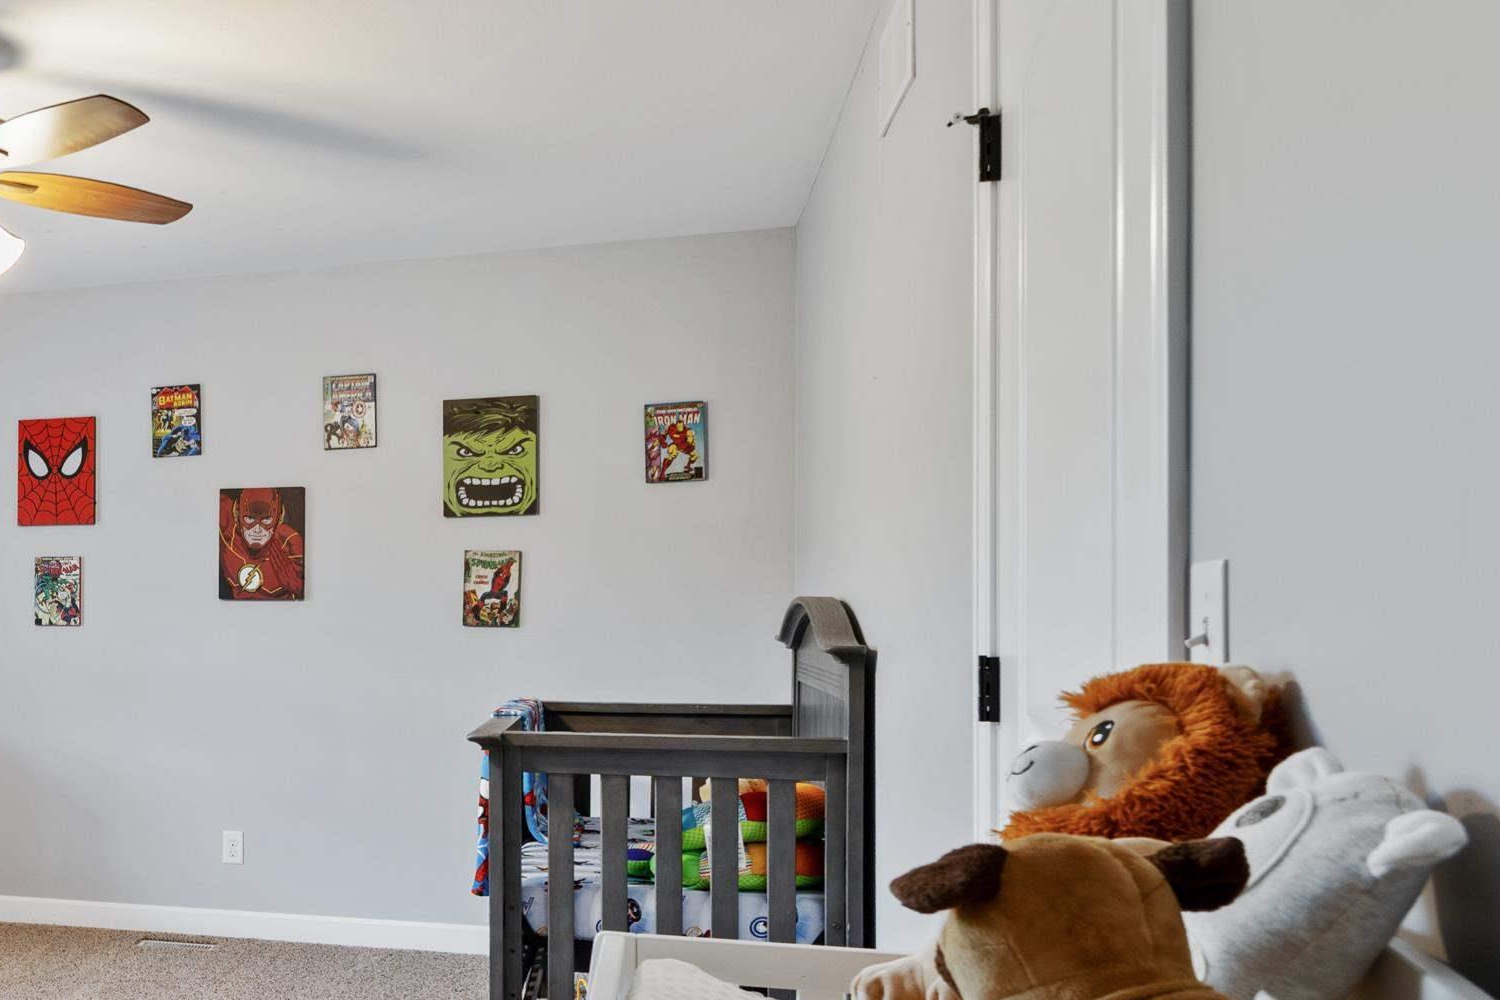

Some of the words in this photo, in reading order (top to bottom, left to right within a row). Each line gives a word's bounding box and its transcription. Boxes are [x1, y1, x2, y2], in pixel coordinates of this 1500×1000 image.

[158, 392, 192, 406] BATMAN
[654, 414, 677, 426] IRON
[679, 412, 701, 424] MAN
